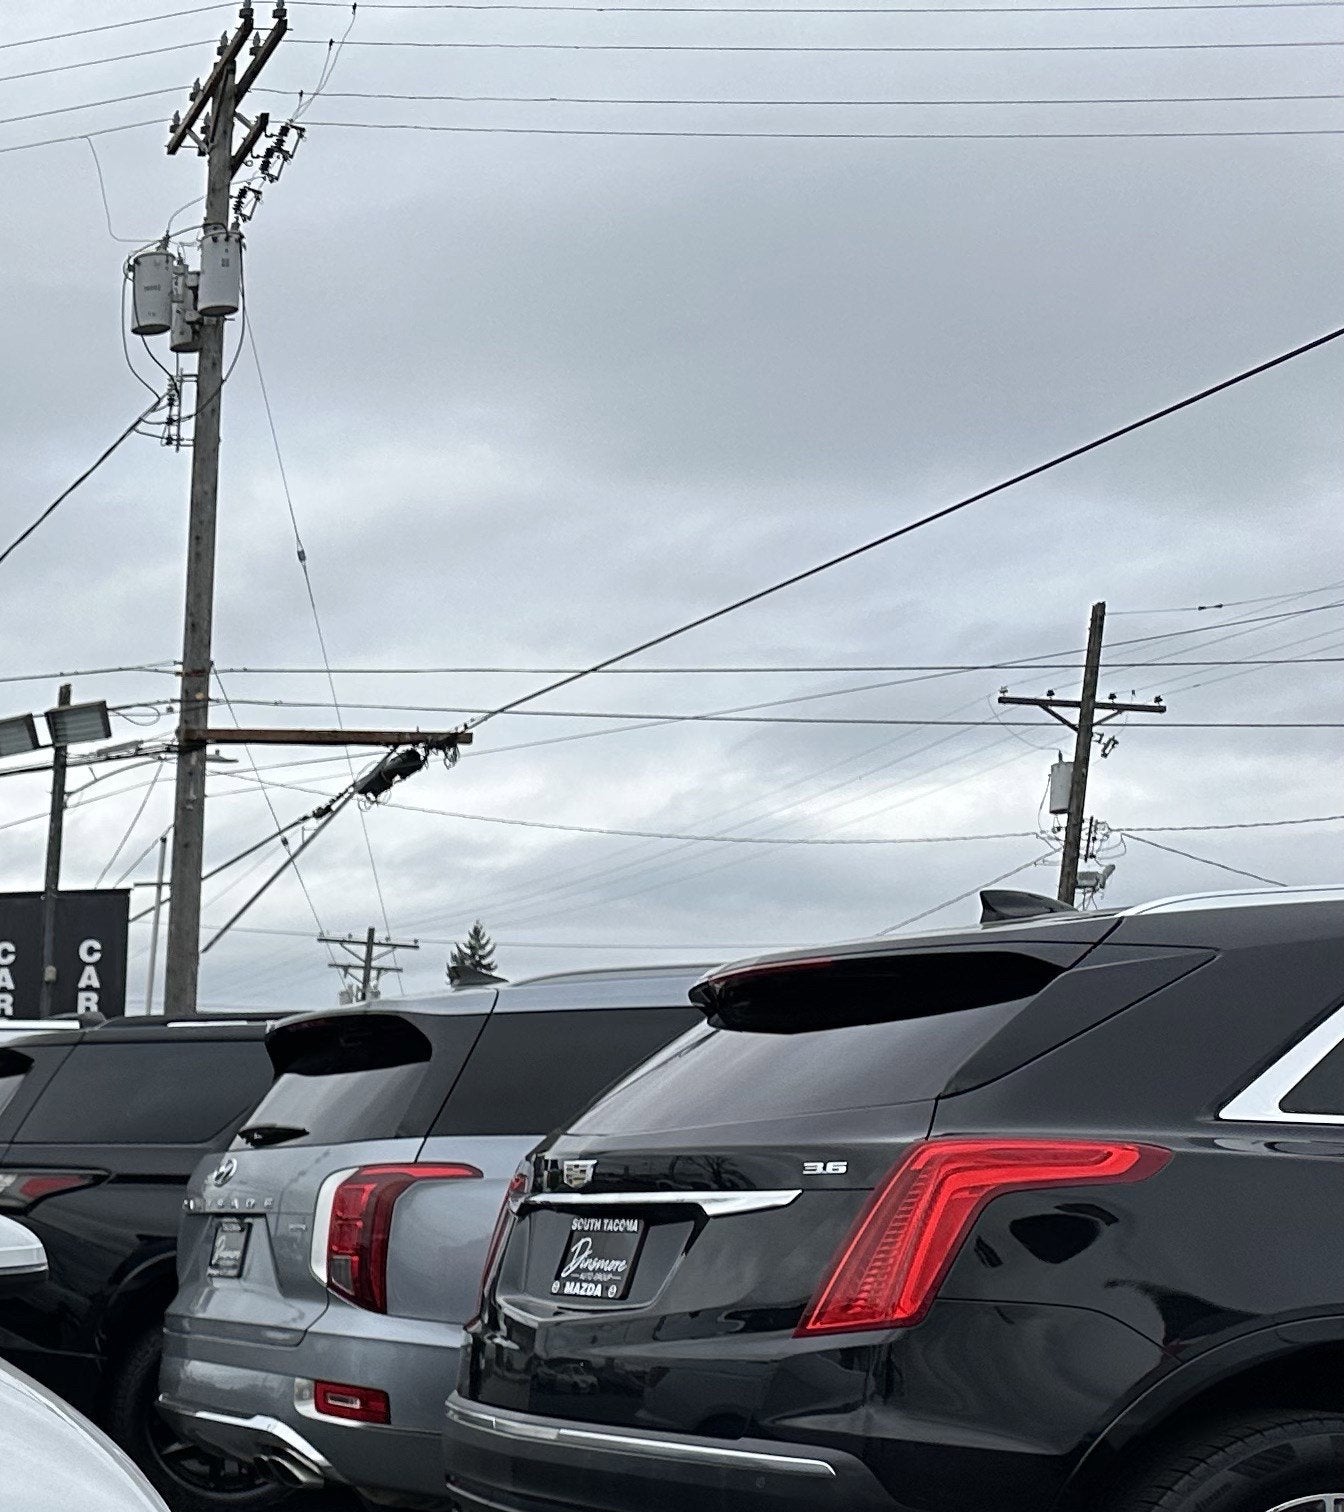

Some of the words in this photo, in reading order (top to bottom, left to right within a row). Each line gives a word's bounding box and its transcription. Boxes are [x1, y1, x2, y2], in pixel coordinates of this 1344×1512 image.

[572, 1218, 601, 1231] SOUTH
[603, 1219, 638, 1231] TACOMA
[564, 1281, 602, 1297] MAZDA
